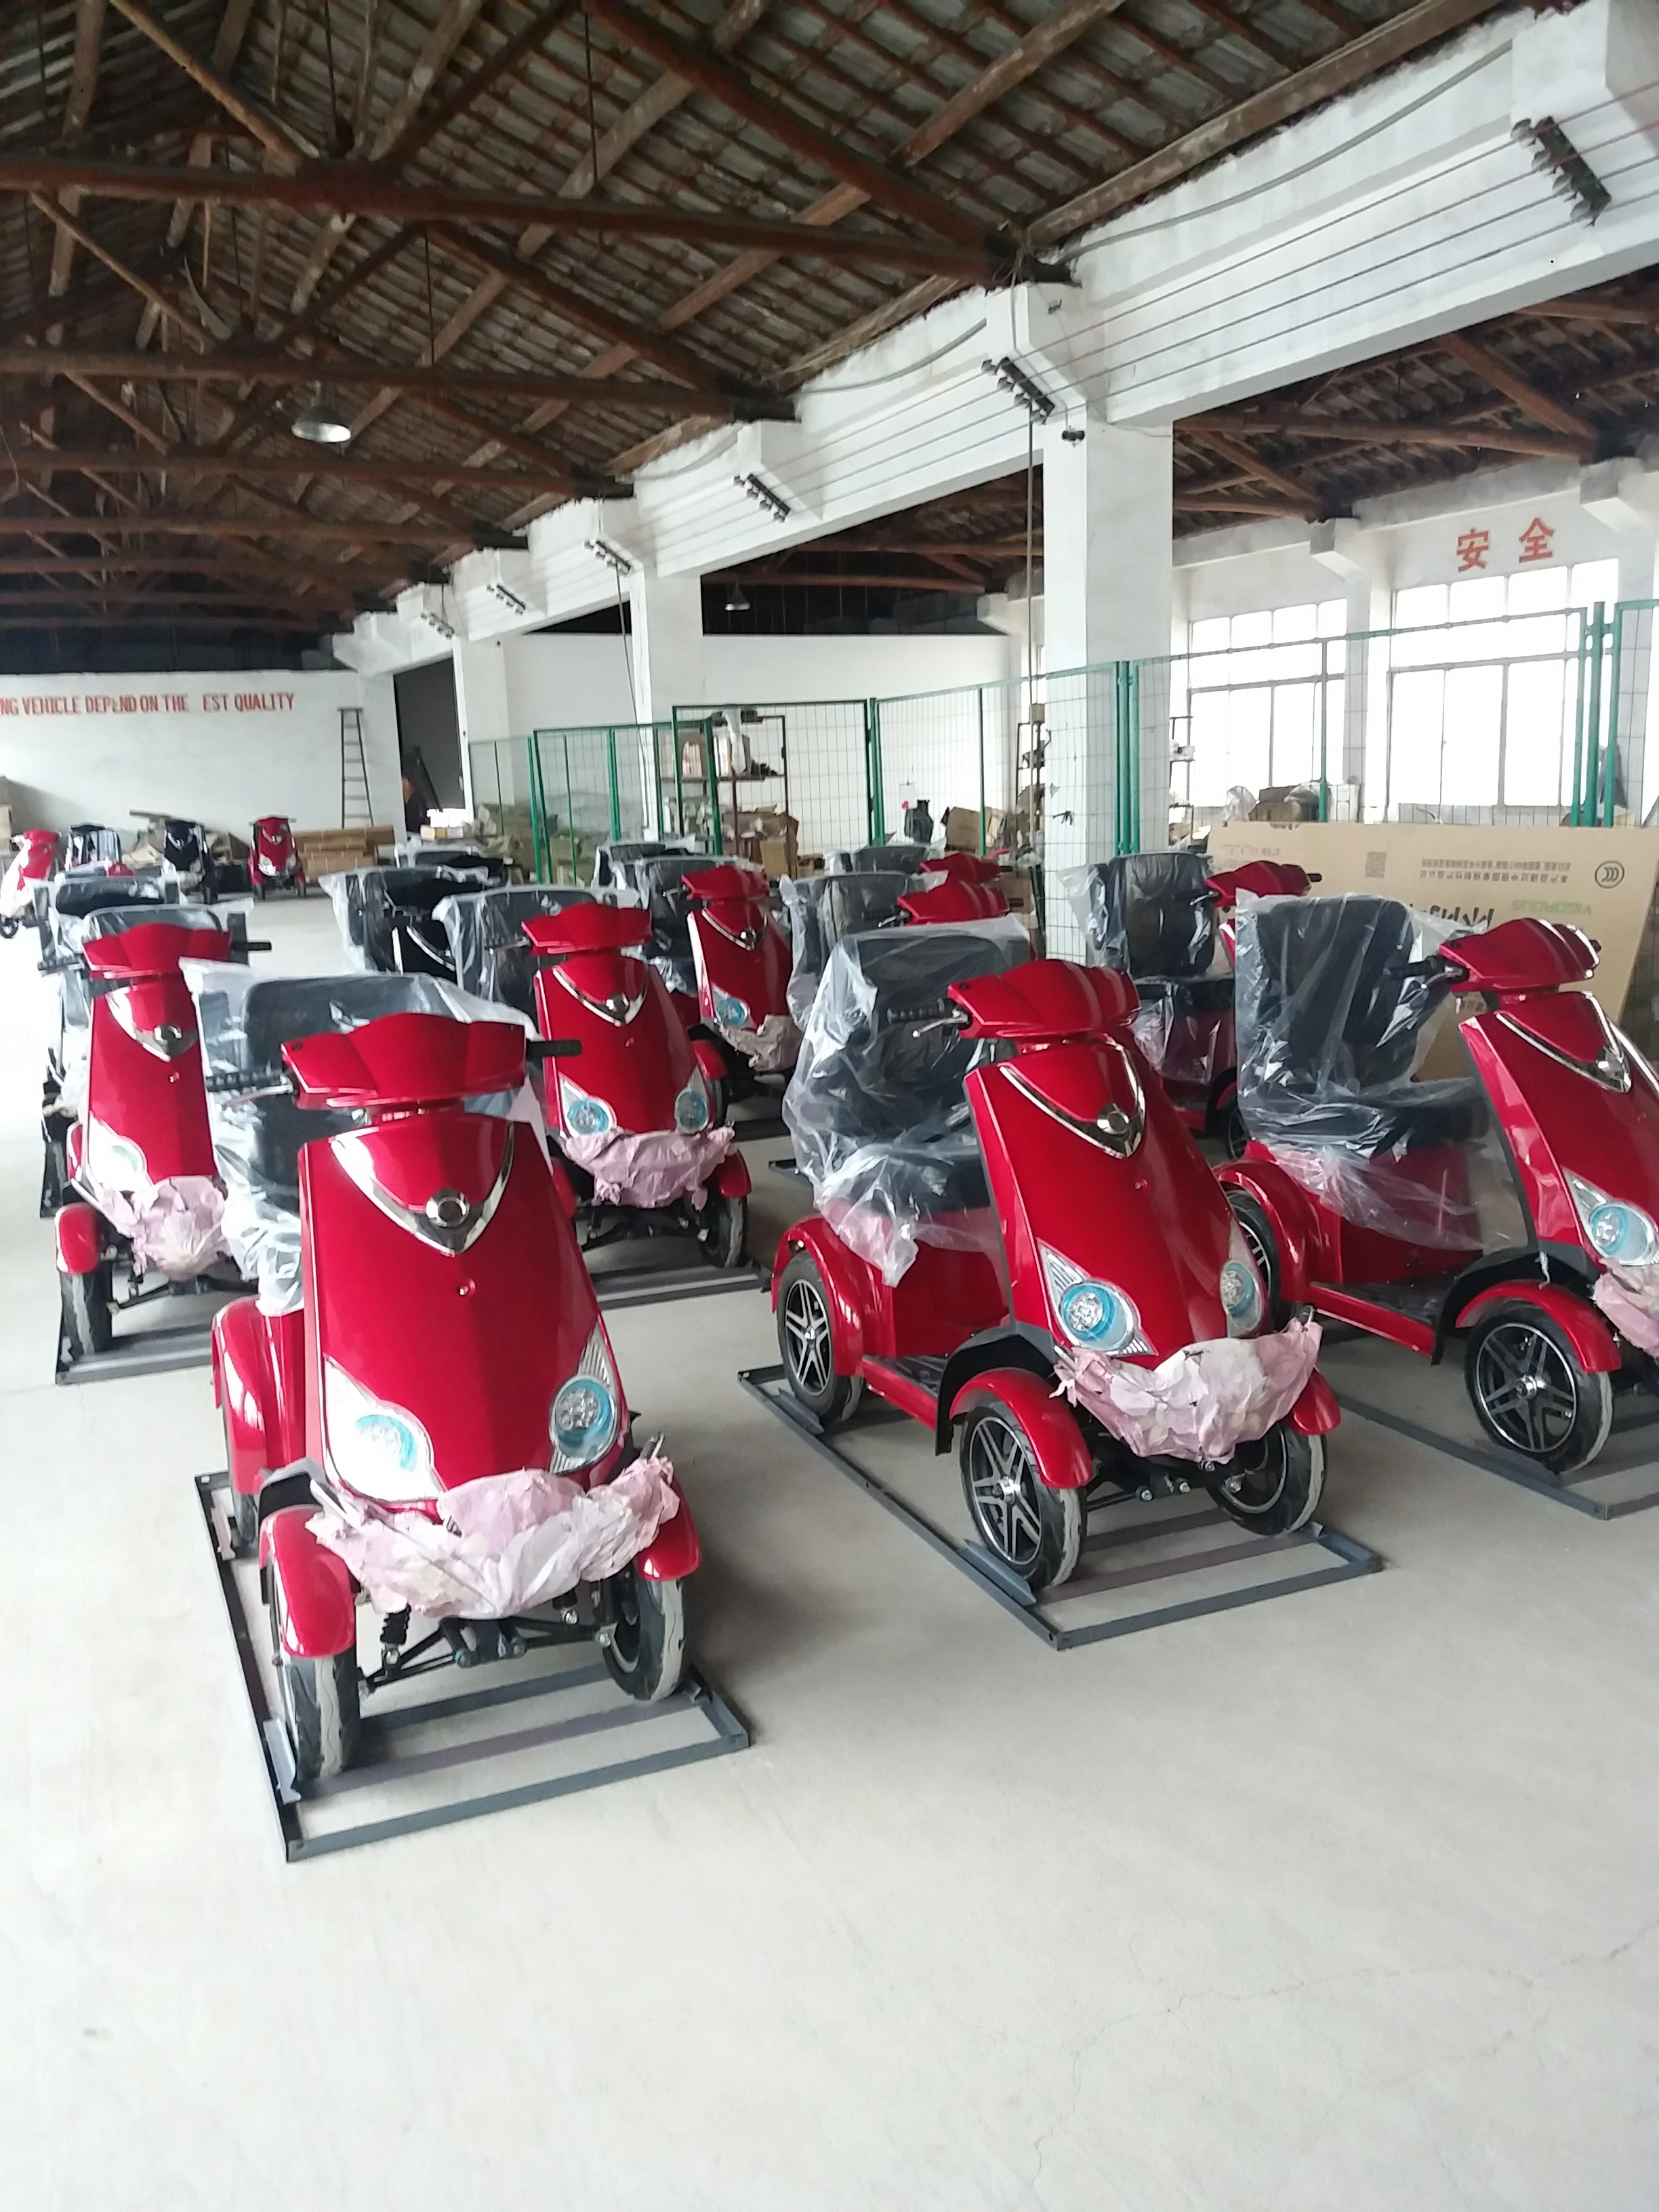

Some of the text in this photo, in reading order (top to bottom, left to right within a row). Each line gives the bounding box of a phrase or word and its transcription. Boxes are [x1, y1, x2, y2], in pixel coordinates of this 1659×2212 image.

[1456, 516, 1555, 573] 安全
[22, 695, 80, 714] VEHICLE
[140, 695, 159, 712] ON
[161, 693, 189, 712] THE
[234, 691, 295, 712] QUALITY
